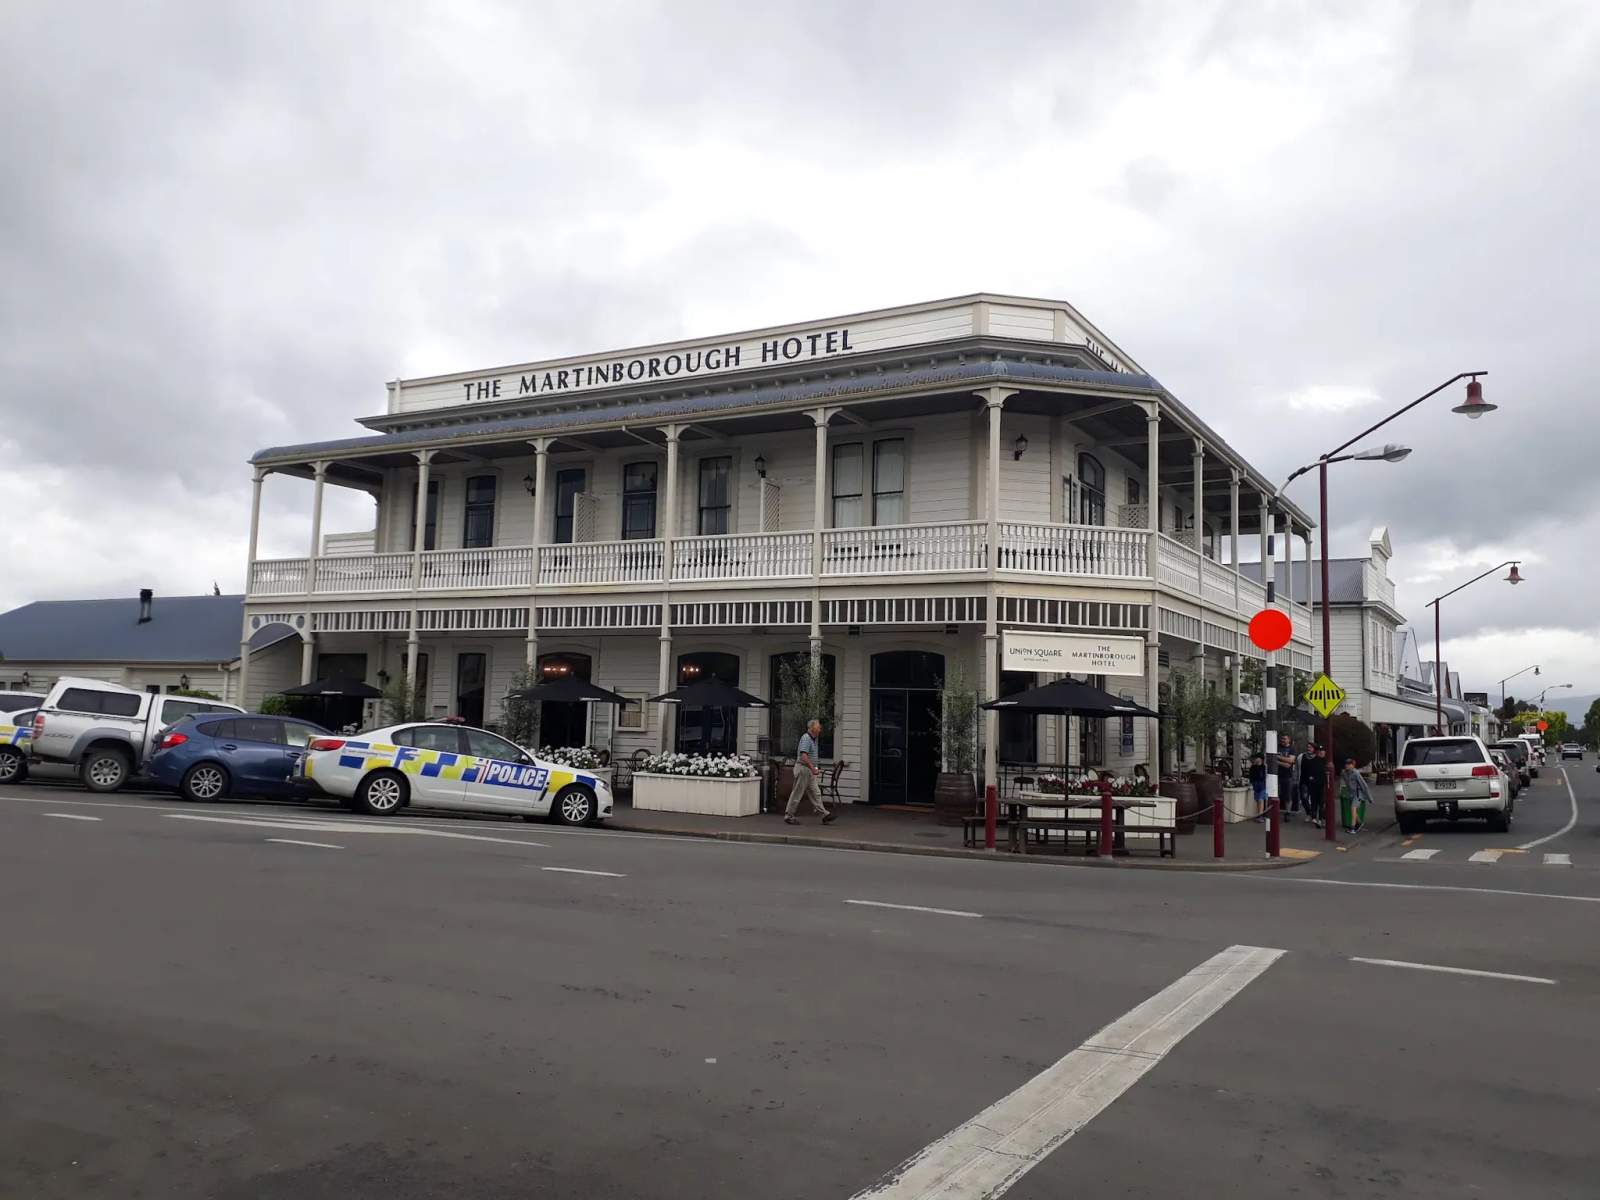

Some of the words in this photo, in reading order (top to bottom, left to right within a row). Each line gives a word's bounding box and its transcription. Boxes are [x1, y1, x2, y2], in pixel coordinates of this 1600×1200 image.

[464, 380, 502, 401] THE
[519, 346, 742, 394] MARTINBOROUGH
[762, 329, 853, 363] HOTEL
[1033, 648, 1063, 658] SQUARE
[1071, 651, 1136, 661] MARTINBOROUGH
[1091, 659, 1116, 667] HOTEL
[487, 763, 546, 787] POLICE
